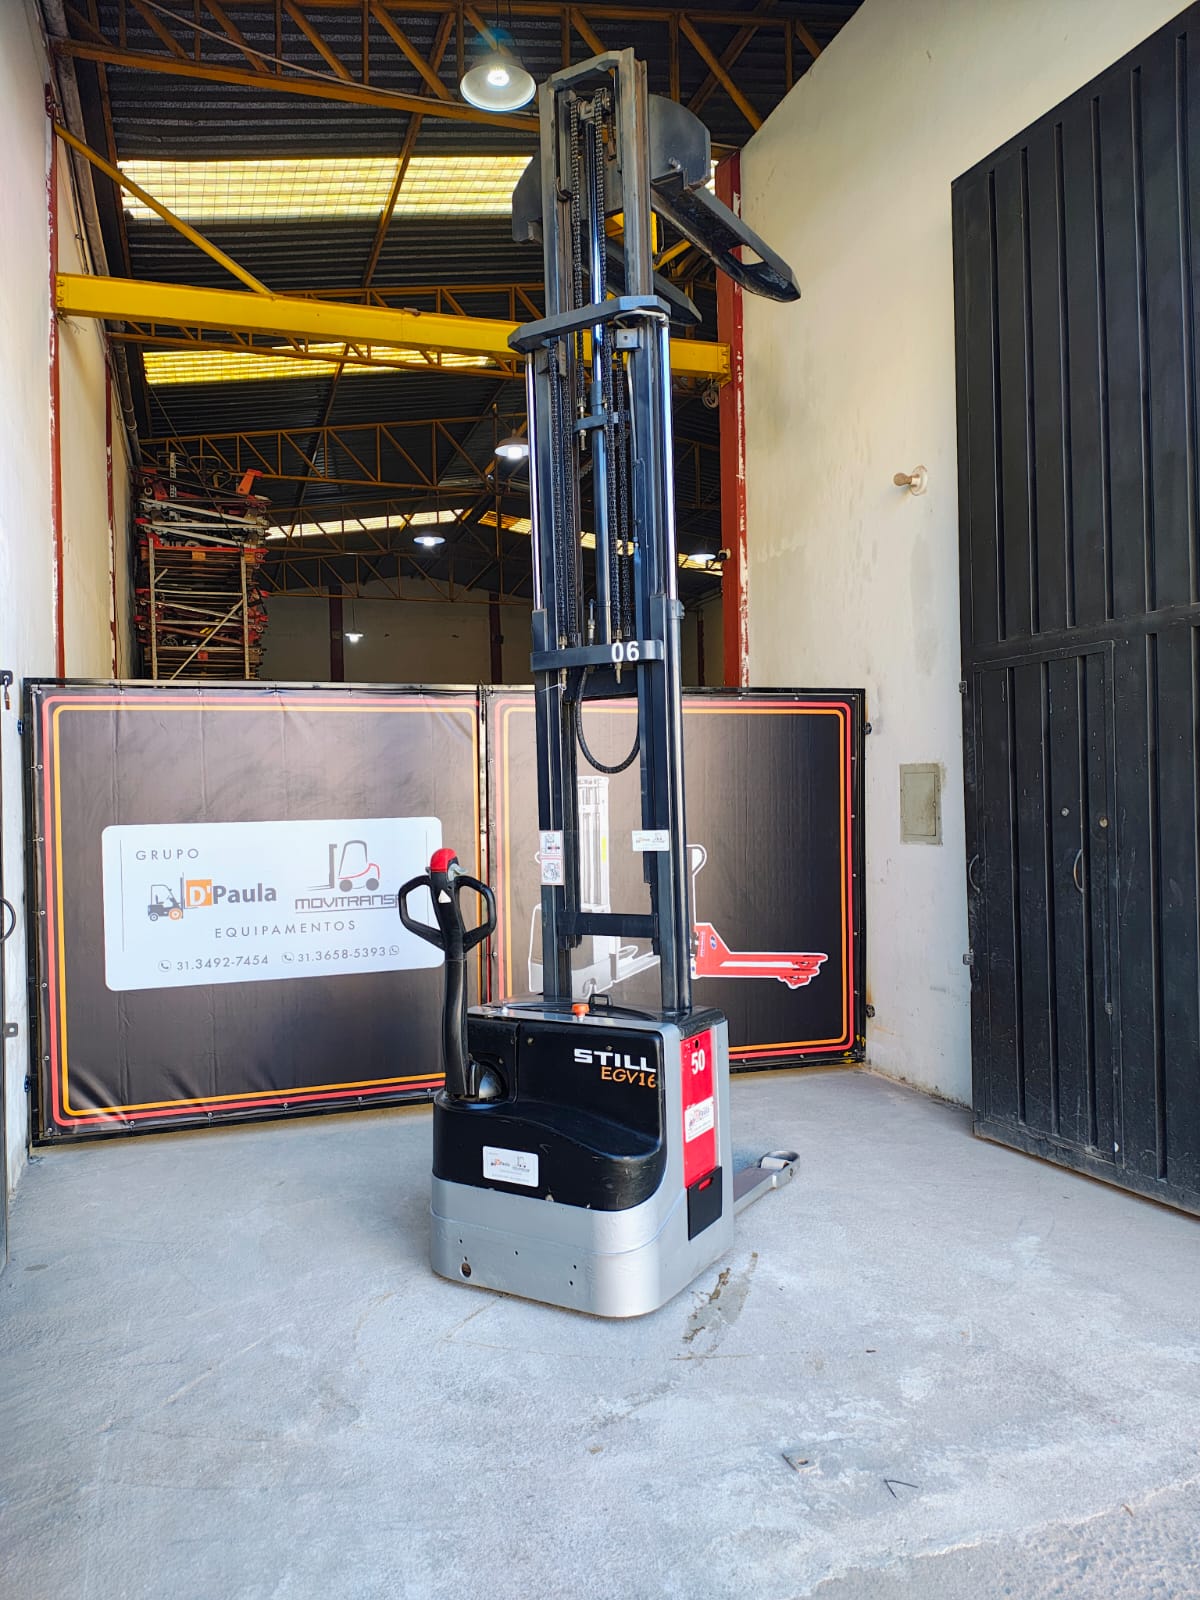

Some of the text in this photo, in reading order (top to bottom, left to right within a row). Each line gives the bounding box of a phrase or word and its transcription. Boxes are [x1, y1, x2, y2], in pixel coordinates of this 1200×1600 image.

[611, 641, 640, 662] 06
[135, 848, 199, 861] GRUPO
[215, 920, 356, 938] EQUIPAMENTOS
[177, 946, 386, 971] 31.3492-7454 31.3658-5393
[574, 1048, 657, 1073] STILL
[691, 1049, 706, 1075] 50
[601, 1066, 657, 1089] EGV16
